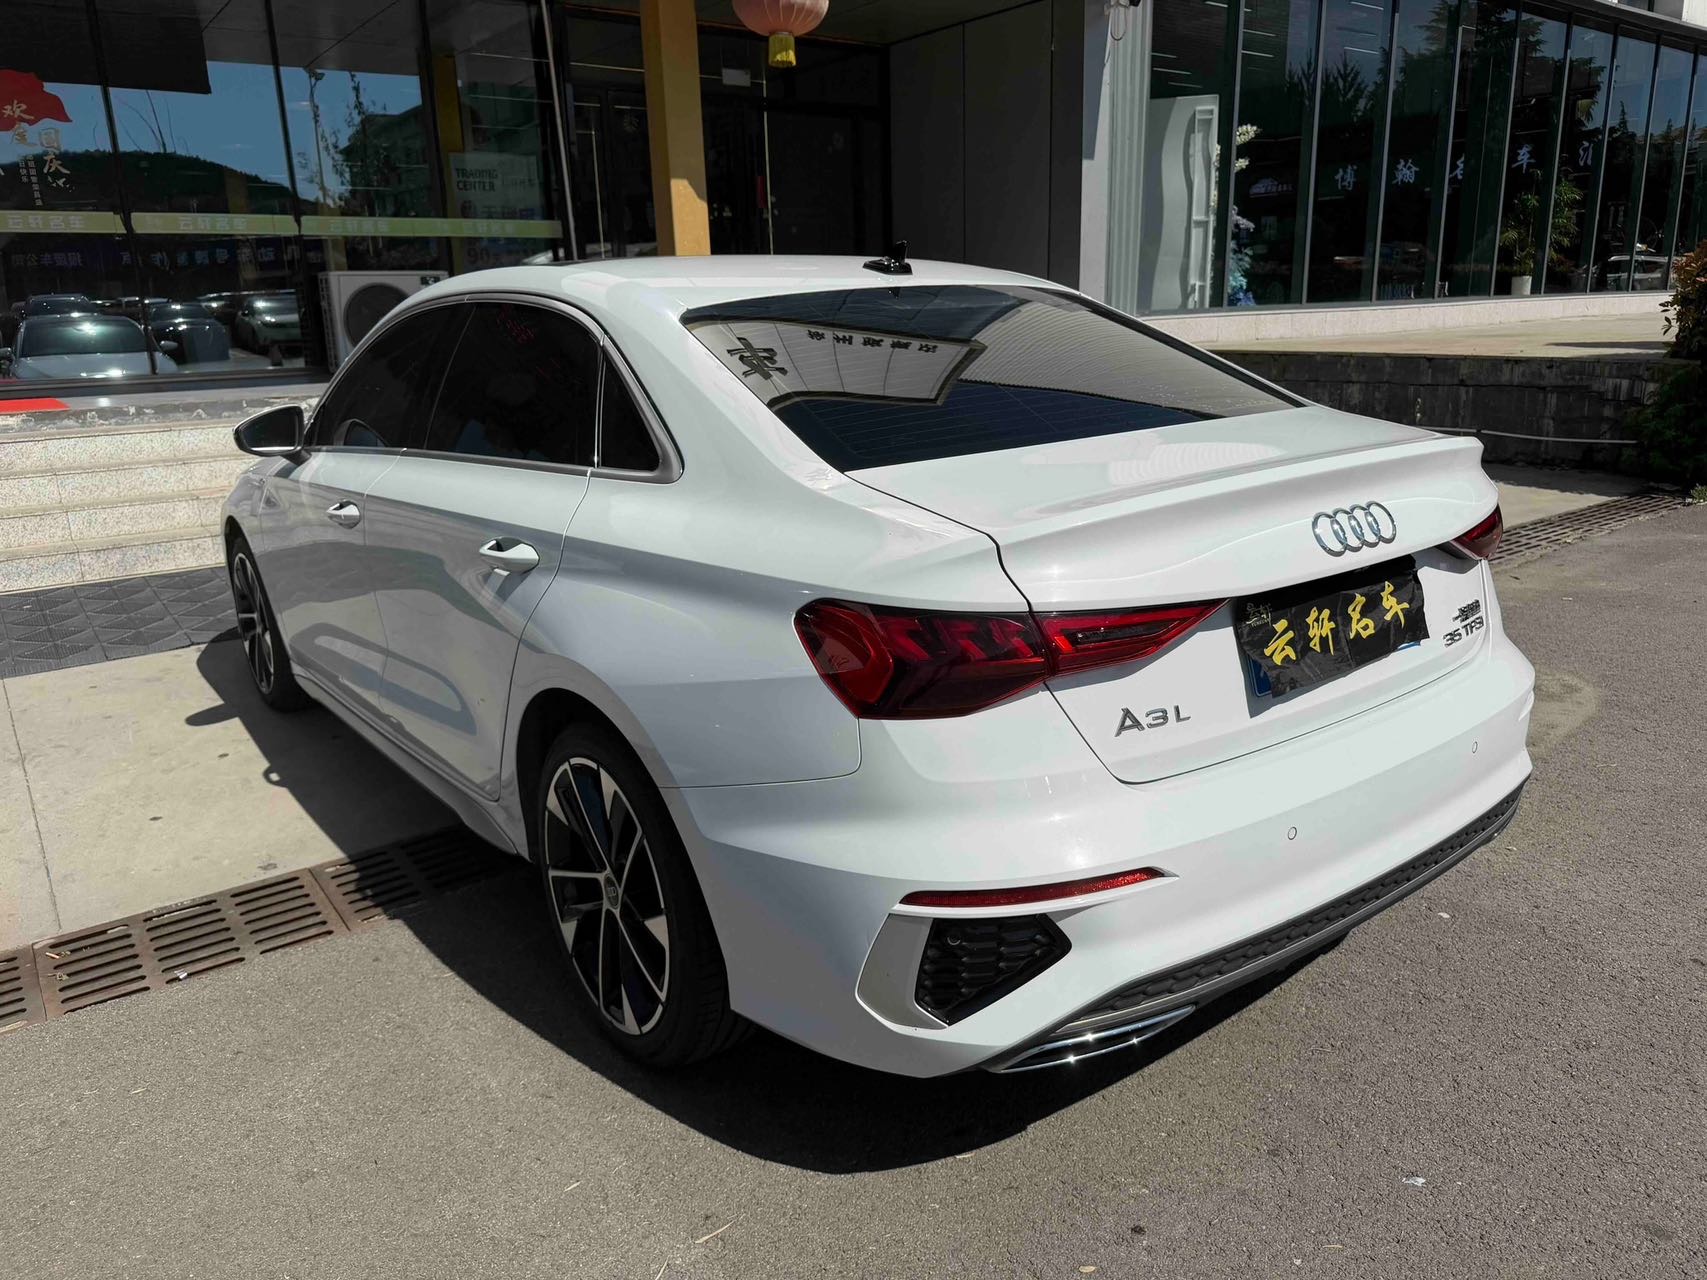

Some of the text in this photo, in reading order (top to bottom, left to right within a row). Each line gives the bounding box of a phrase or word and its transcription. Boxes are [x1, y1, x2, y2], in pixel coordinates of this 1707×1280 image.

[456, 180, 496, 192] CENTER
[1263, 580, 1410, 666] 云轩名车
[1442, 628, 1462, 648] 35
